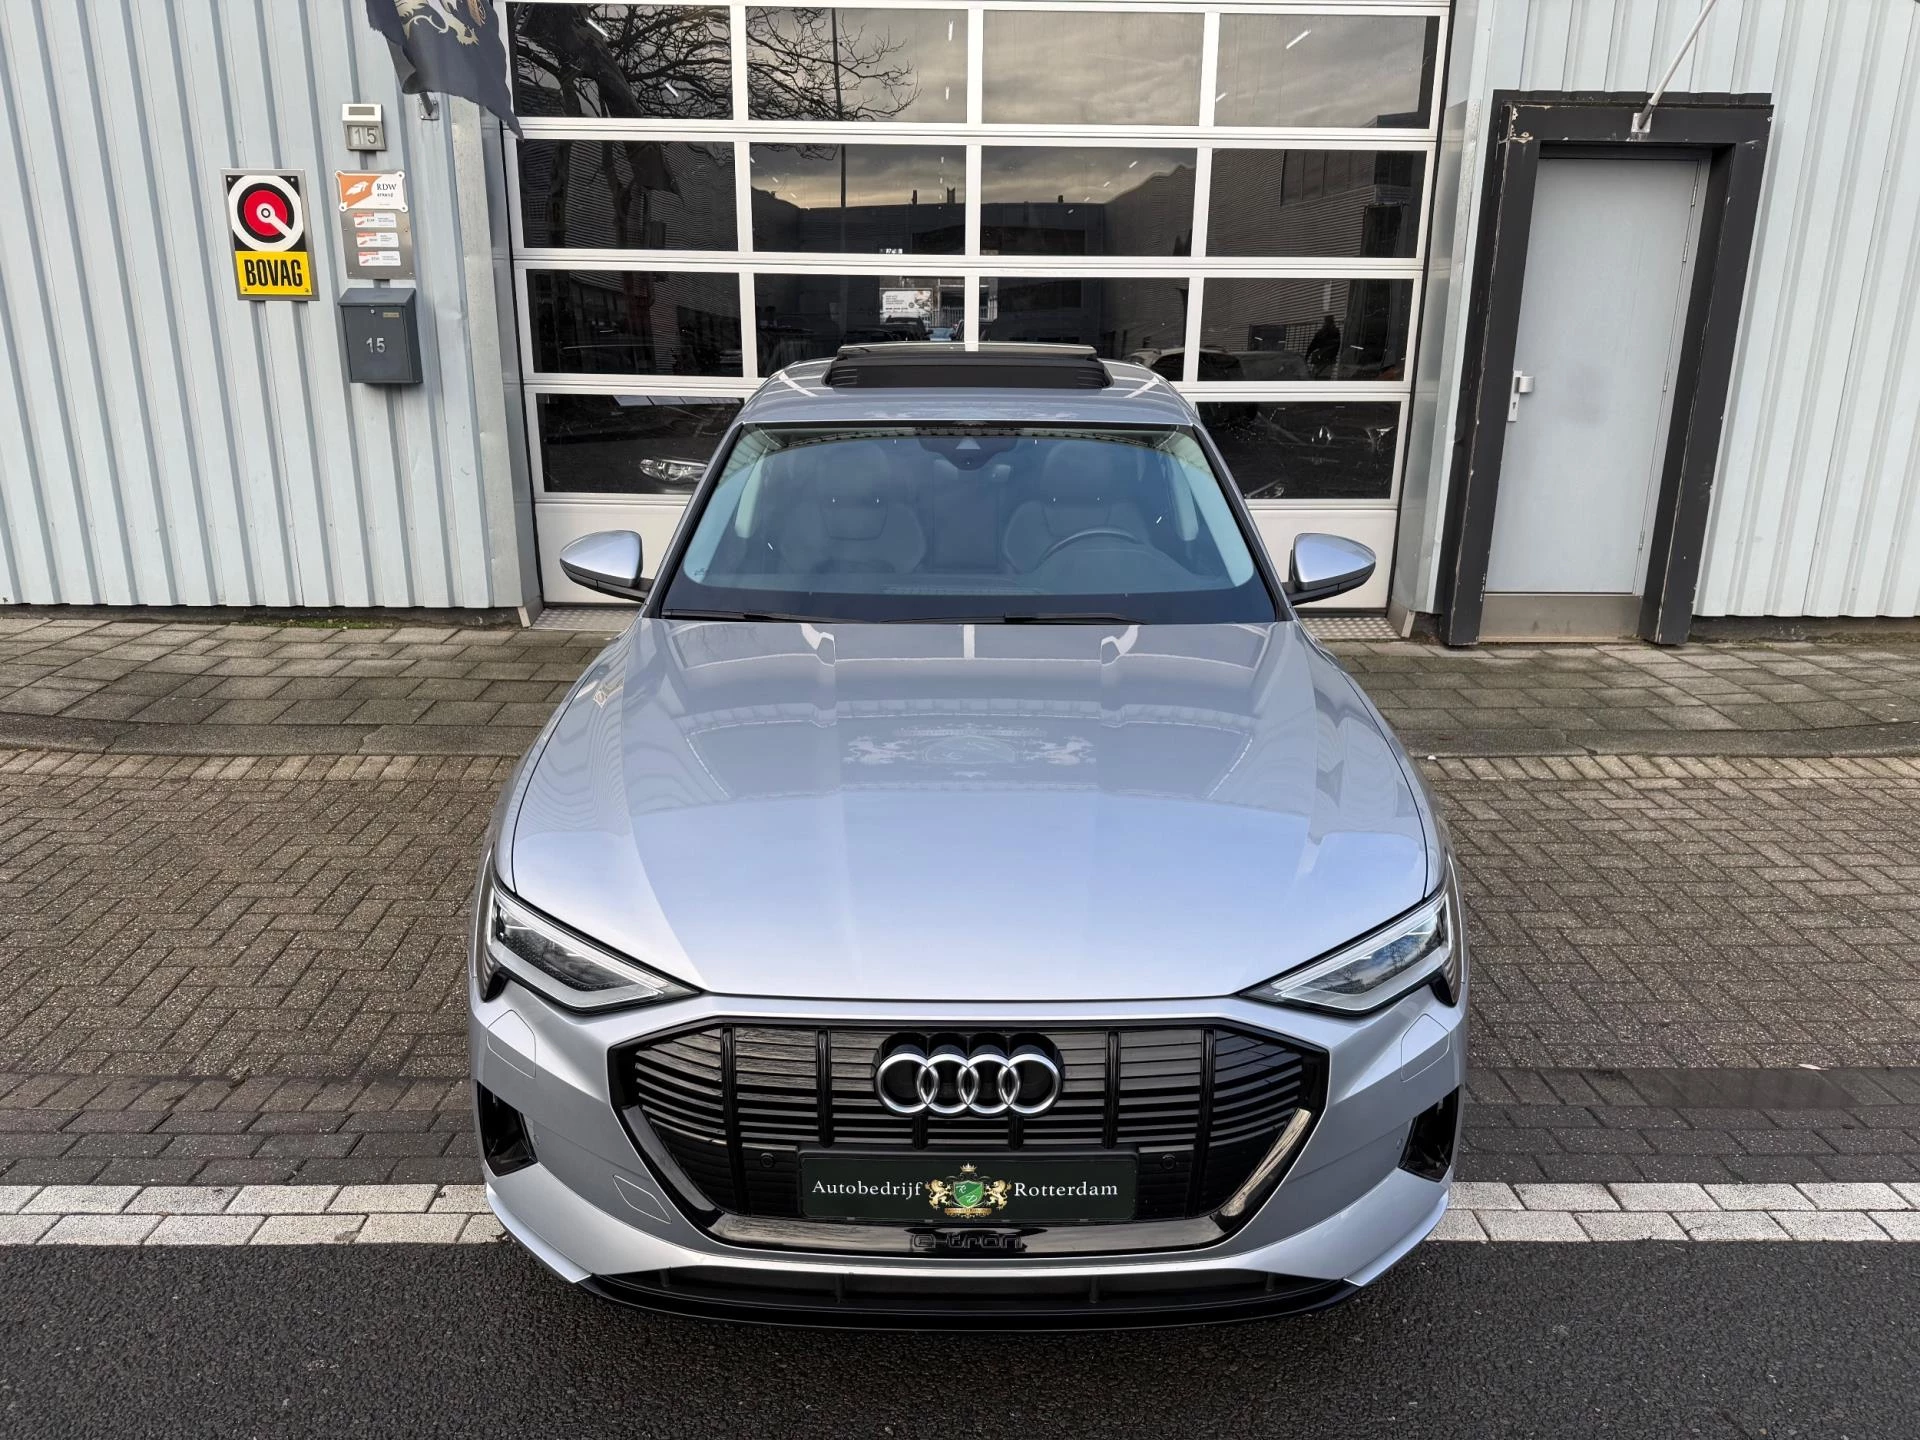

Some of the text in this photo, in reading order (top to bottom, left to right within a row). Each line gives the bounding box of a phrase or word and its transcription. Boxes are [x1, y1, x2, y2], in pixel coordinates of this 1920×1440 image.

[355, 128, 377, 144] 15
[376, 183, 397, 191] RDW
[244, 259, 303, 287] BOVAG
[366, 337, 386, 353] 15
[812, 1180, 1118, 1200] Autobedrijf Rotterdam
[912, 1232, 1023, 1251] e-tron
